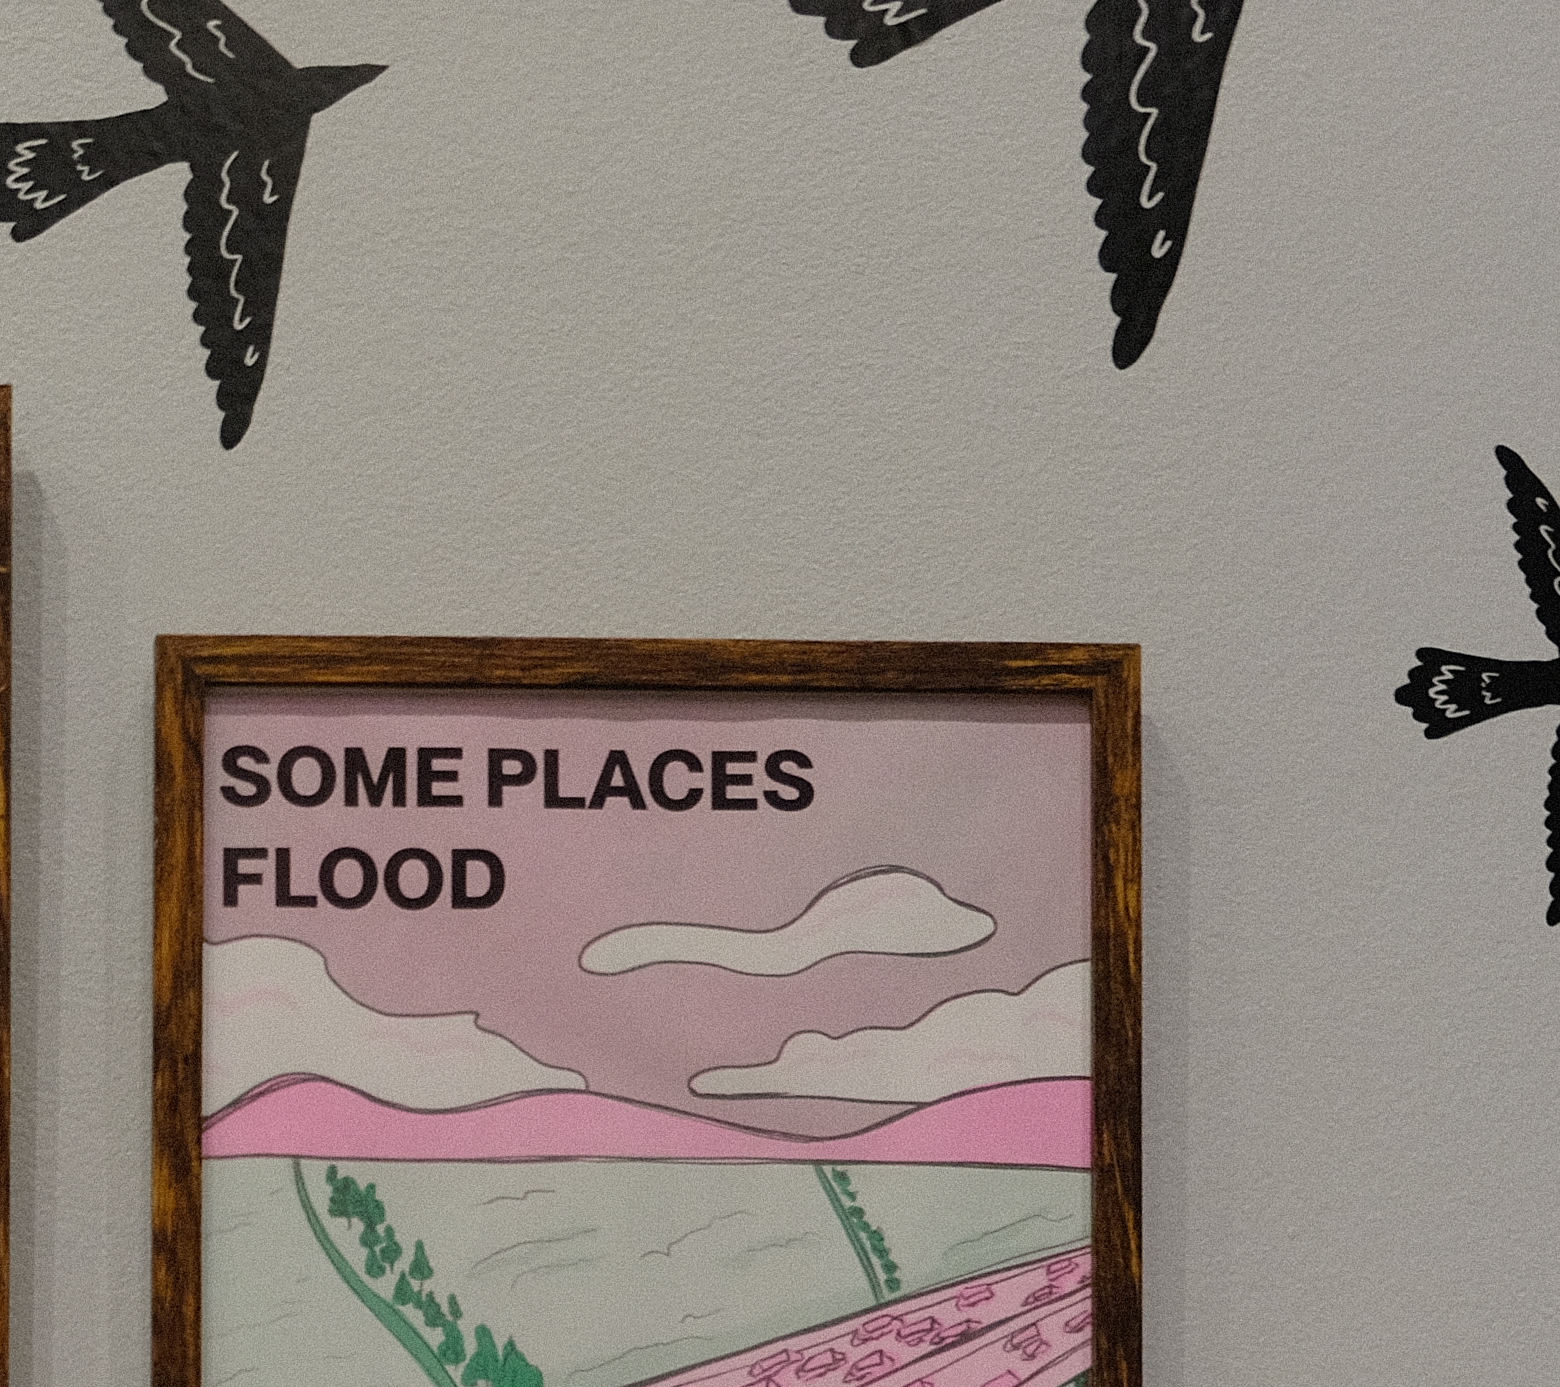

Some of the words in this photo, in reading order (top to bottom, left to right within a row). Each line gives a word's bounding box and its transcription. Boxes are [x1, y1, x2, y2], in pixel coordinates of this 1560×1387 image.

[220, 745, 463, 807] SOME
[488, 748, 814, 811] PLACES
[223, 847, 505, 910] FLOOD
